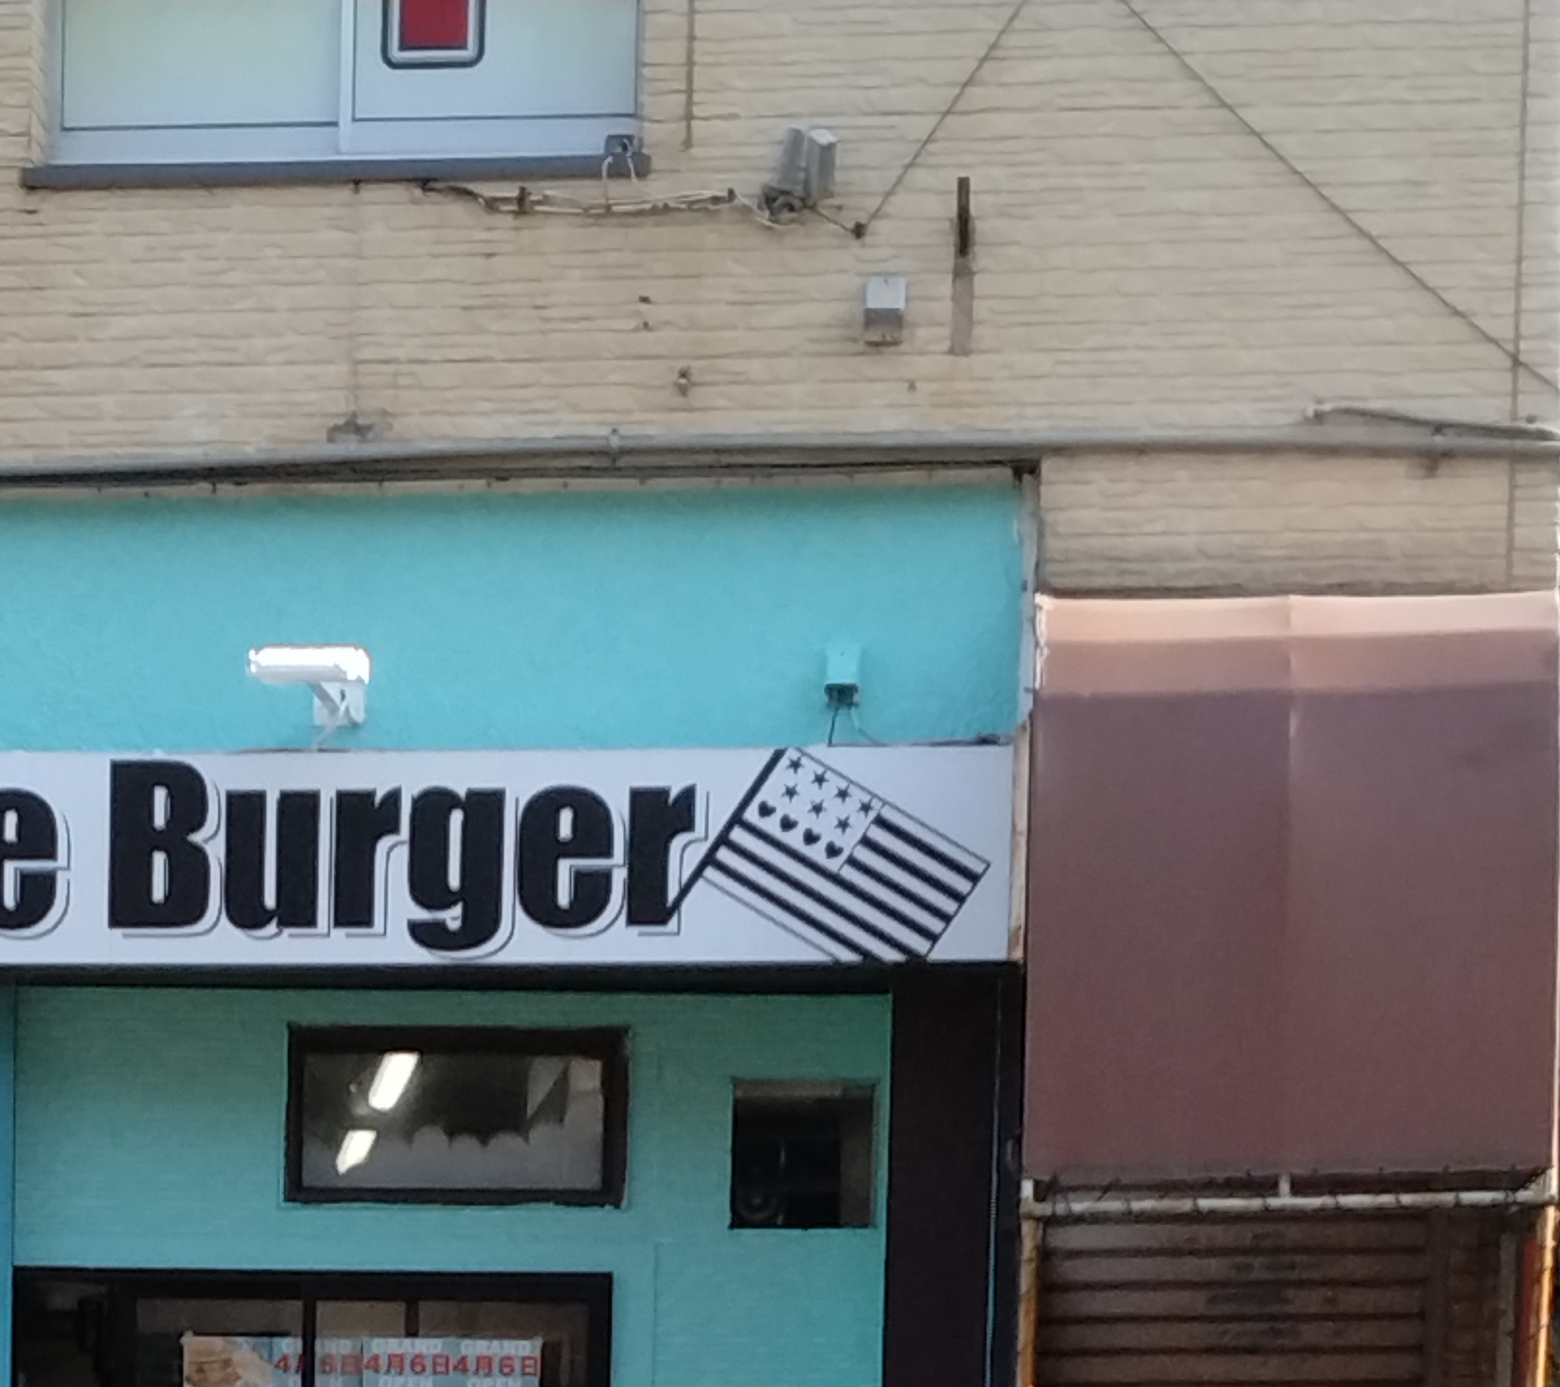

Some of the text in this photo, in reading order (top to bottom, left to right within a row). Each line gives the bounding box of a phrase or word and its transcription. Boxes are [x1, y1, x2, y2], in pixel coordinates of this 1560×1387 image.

[108, 759, 706, 957] Burger
[364, 1353, 450, 1375] 4月6日
[453, 1354, 539, 1376] 4月6日
